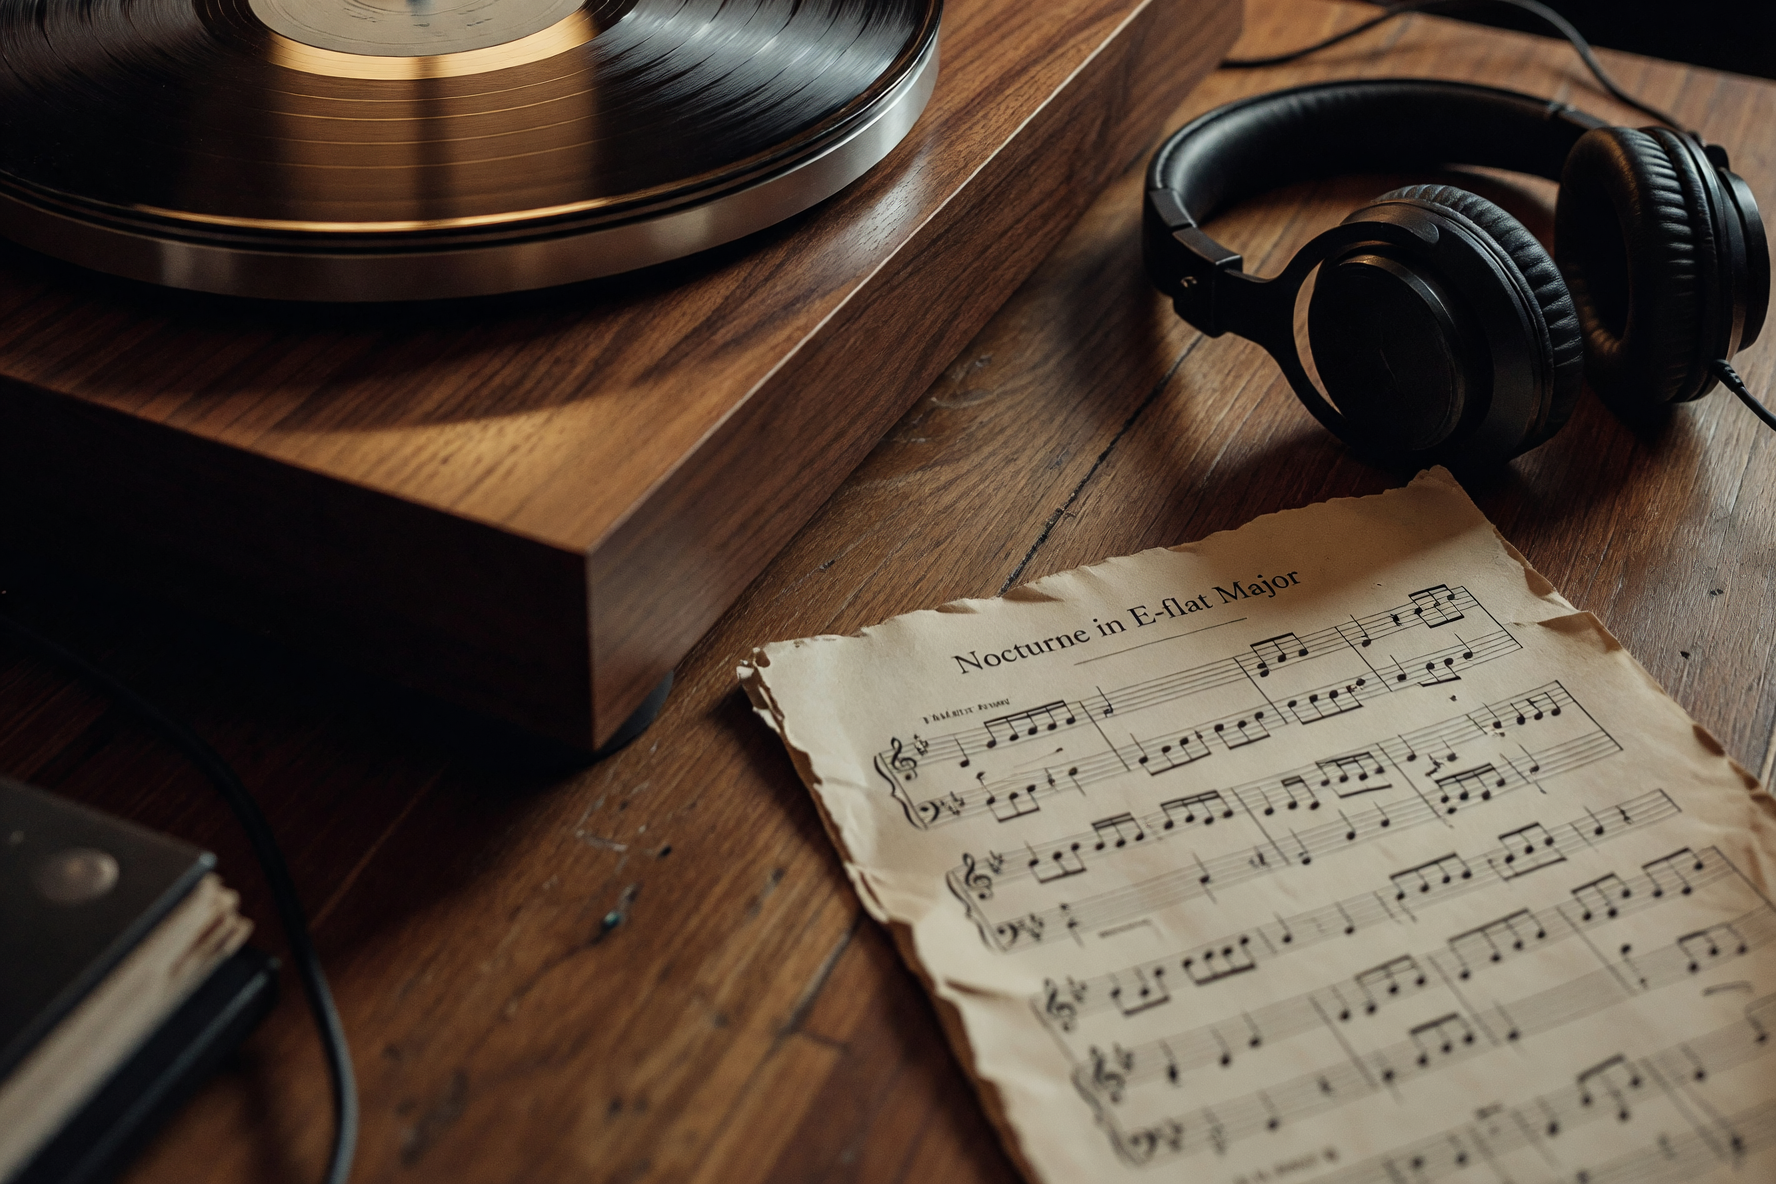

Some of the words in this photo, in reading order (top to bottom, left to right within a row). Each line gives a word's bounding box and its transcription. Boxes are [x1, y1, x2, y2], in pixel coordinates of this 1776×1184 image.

[952, 629, 1091, 674] Nocturne
[1093, 617, 1126, 638] in
[1127, 594, 1213, 627] E-flat
[1212, 568, 1301, 603] Major
